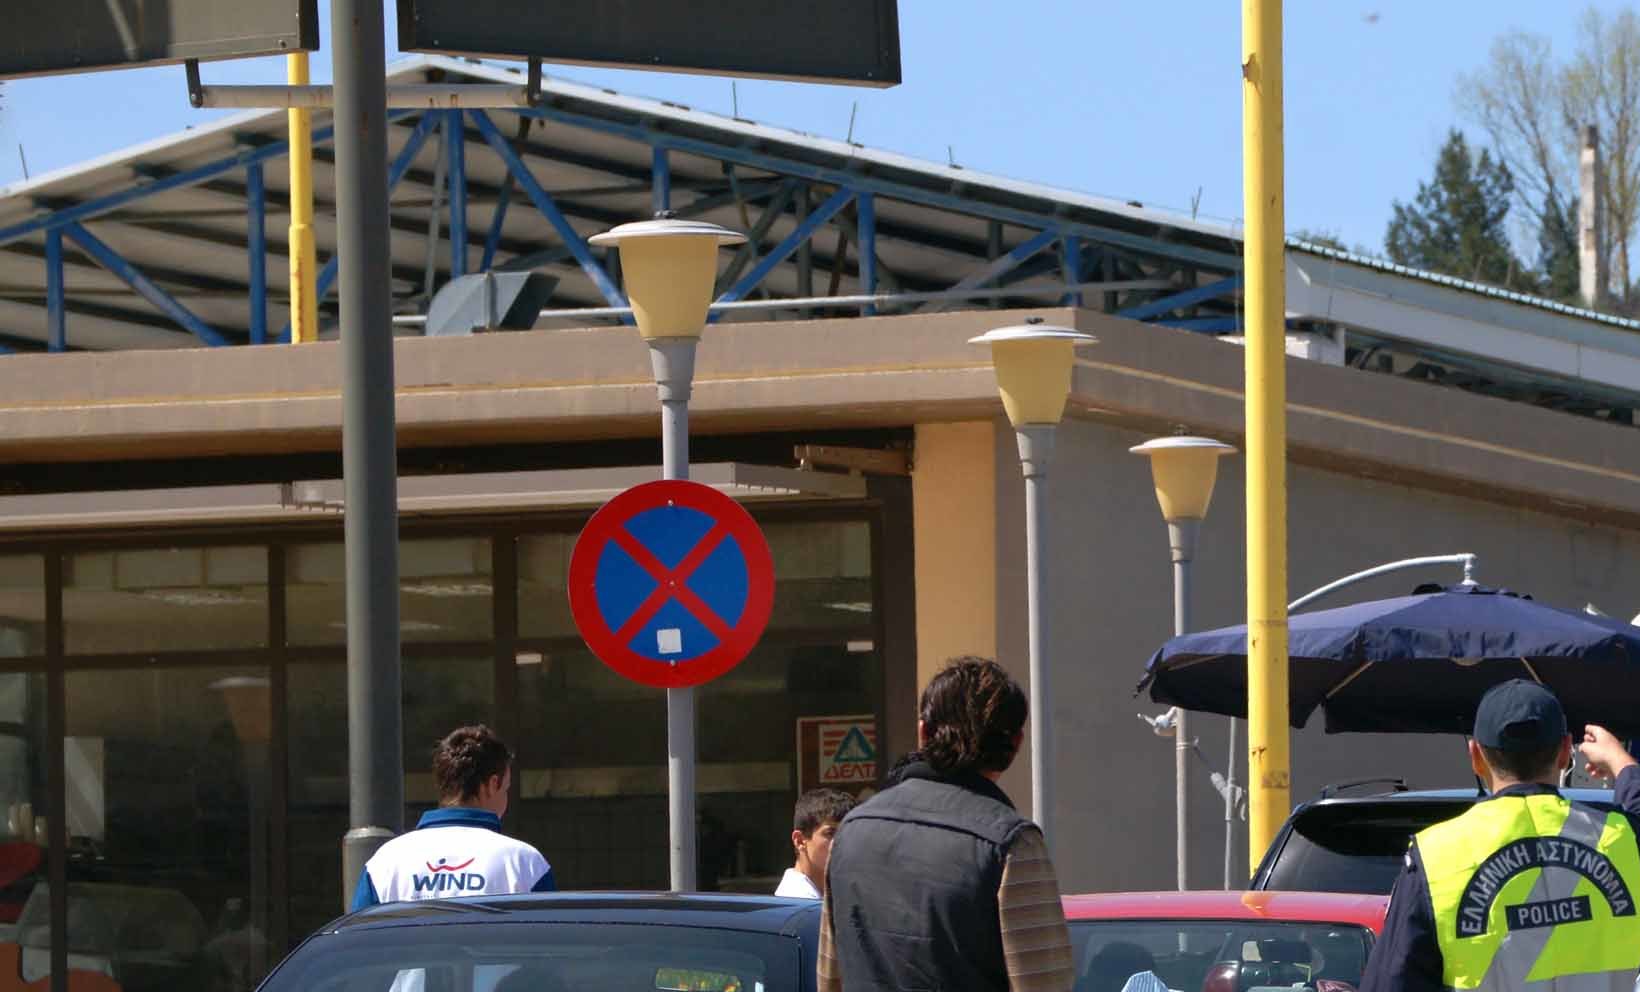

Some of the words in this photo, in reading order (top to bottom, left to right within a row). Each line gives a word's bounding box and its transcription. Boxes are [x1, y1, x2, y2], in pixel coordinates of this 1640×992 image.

[823, 764, 878, 779] ΔΕΛΤ
[412, 872, 486, 892] WIND
[1461, 843, 1531, 934] ΕΛΛΗΝΙΚΗ
[1535, 841, 1630, 915] ΑΣΤΥΝΟΜΙΑ
[1517, 900, 1584, 926] POLICE
